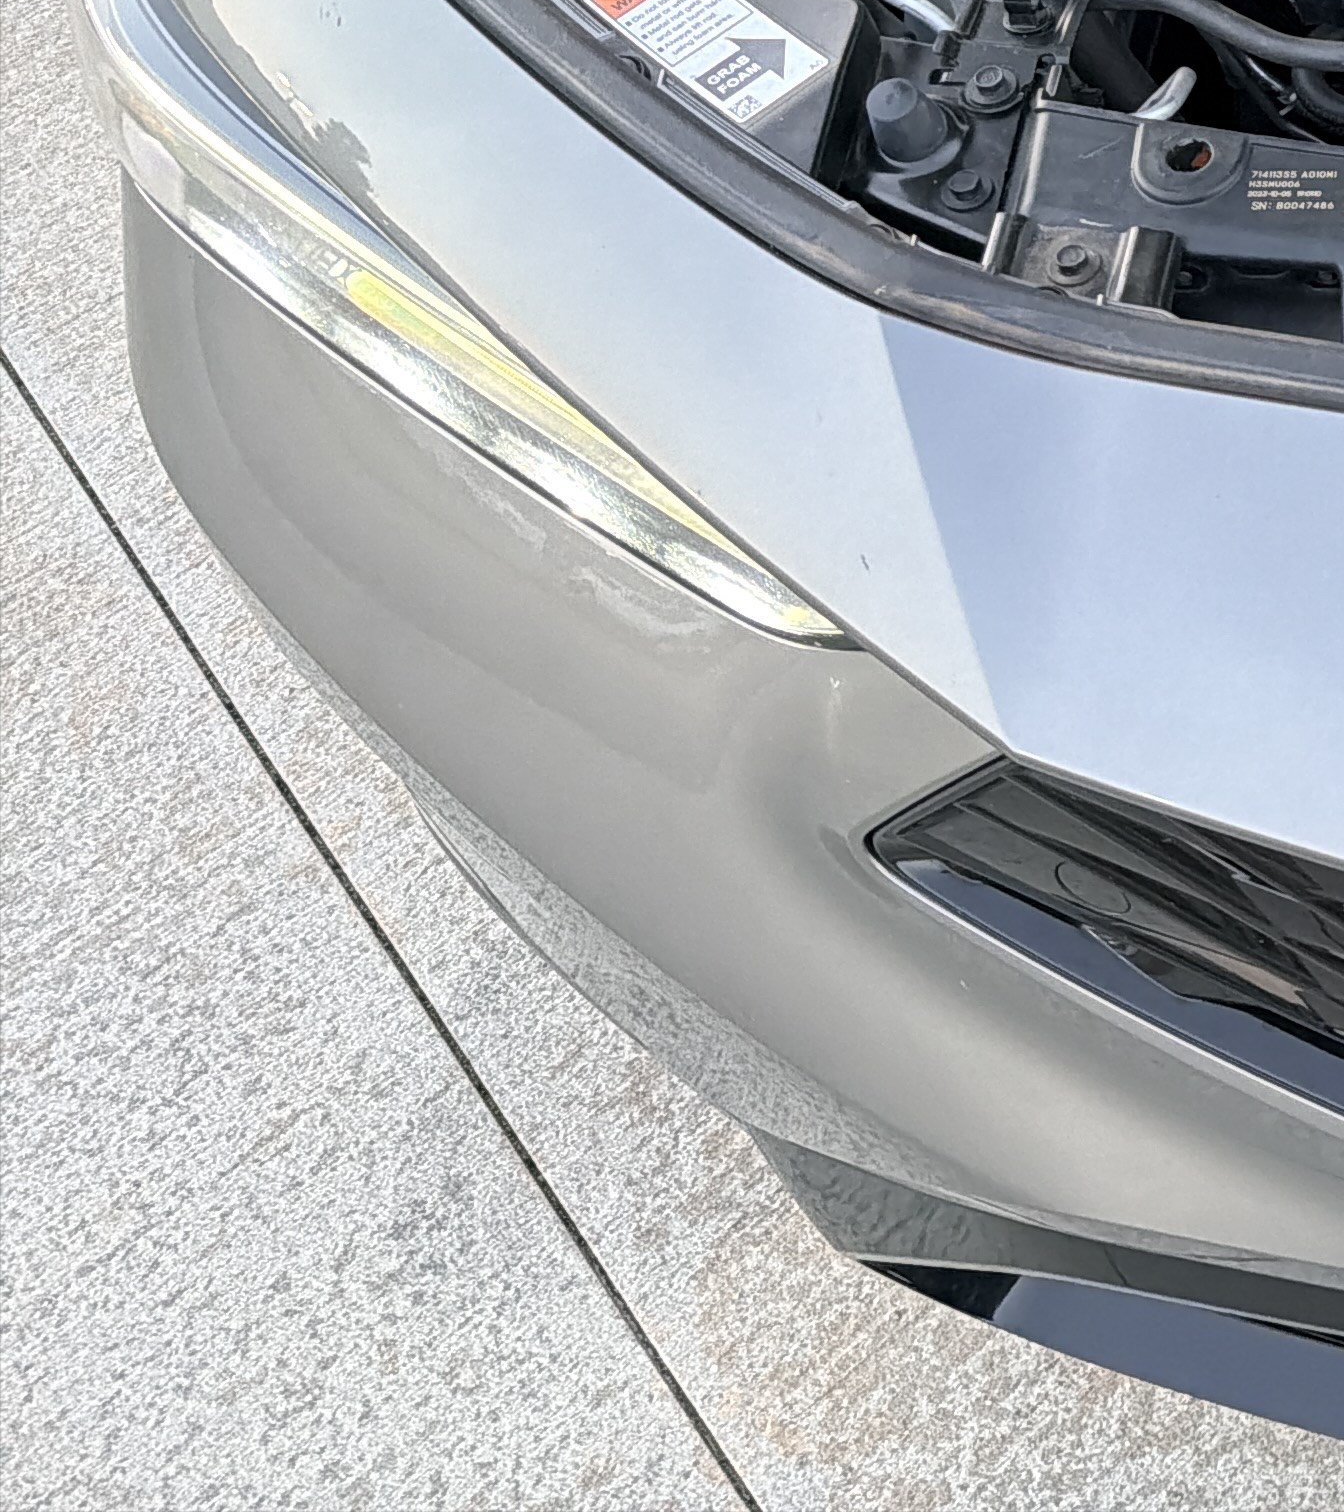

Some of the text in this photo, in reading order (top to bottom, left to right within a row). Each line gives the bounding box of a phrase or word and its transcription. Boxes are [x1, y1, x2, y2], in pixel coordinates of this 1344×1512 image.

[644, 3, 659, 14] not
[669, 10, 684, 21] rod
[684, 0, 702, 13] gets
[640, 12, 662, 30] metal
[656, 29, 672, 42] and
[671, 20, 687, 32] can
[685, 7, 705, 22] burn
[664, 29, 692, 49] Always
[671, 39, 695, 55] using
[692, 25, 714, 41] foam
[707, 55, 750, 84] GRAB
[717, 62, 761, 93] FOAM
[1251, 201, 1273, 211] SN:
